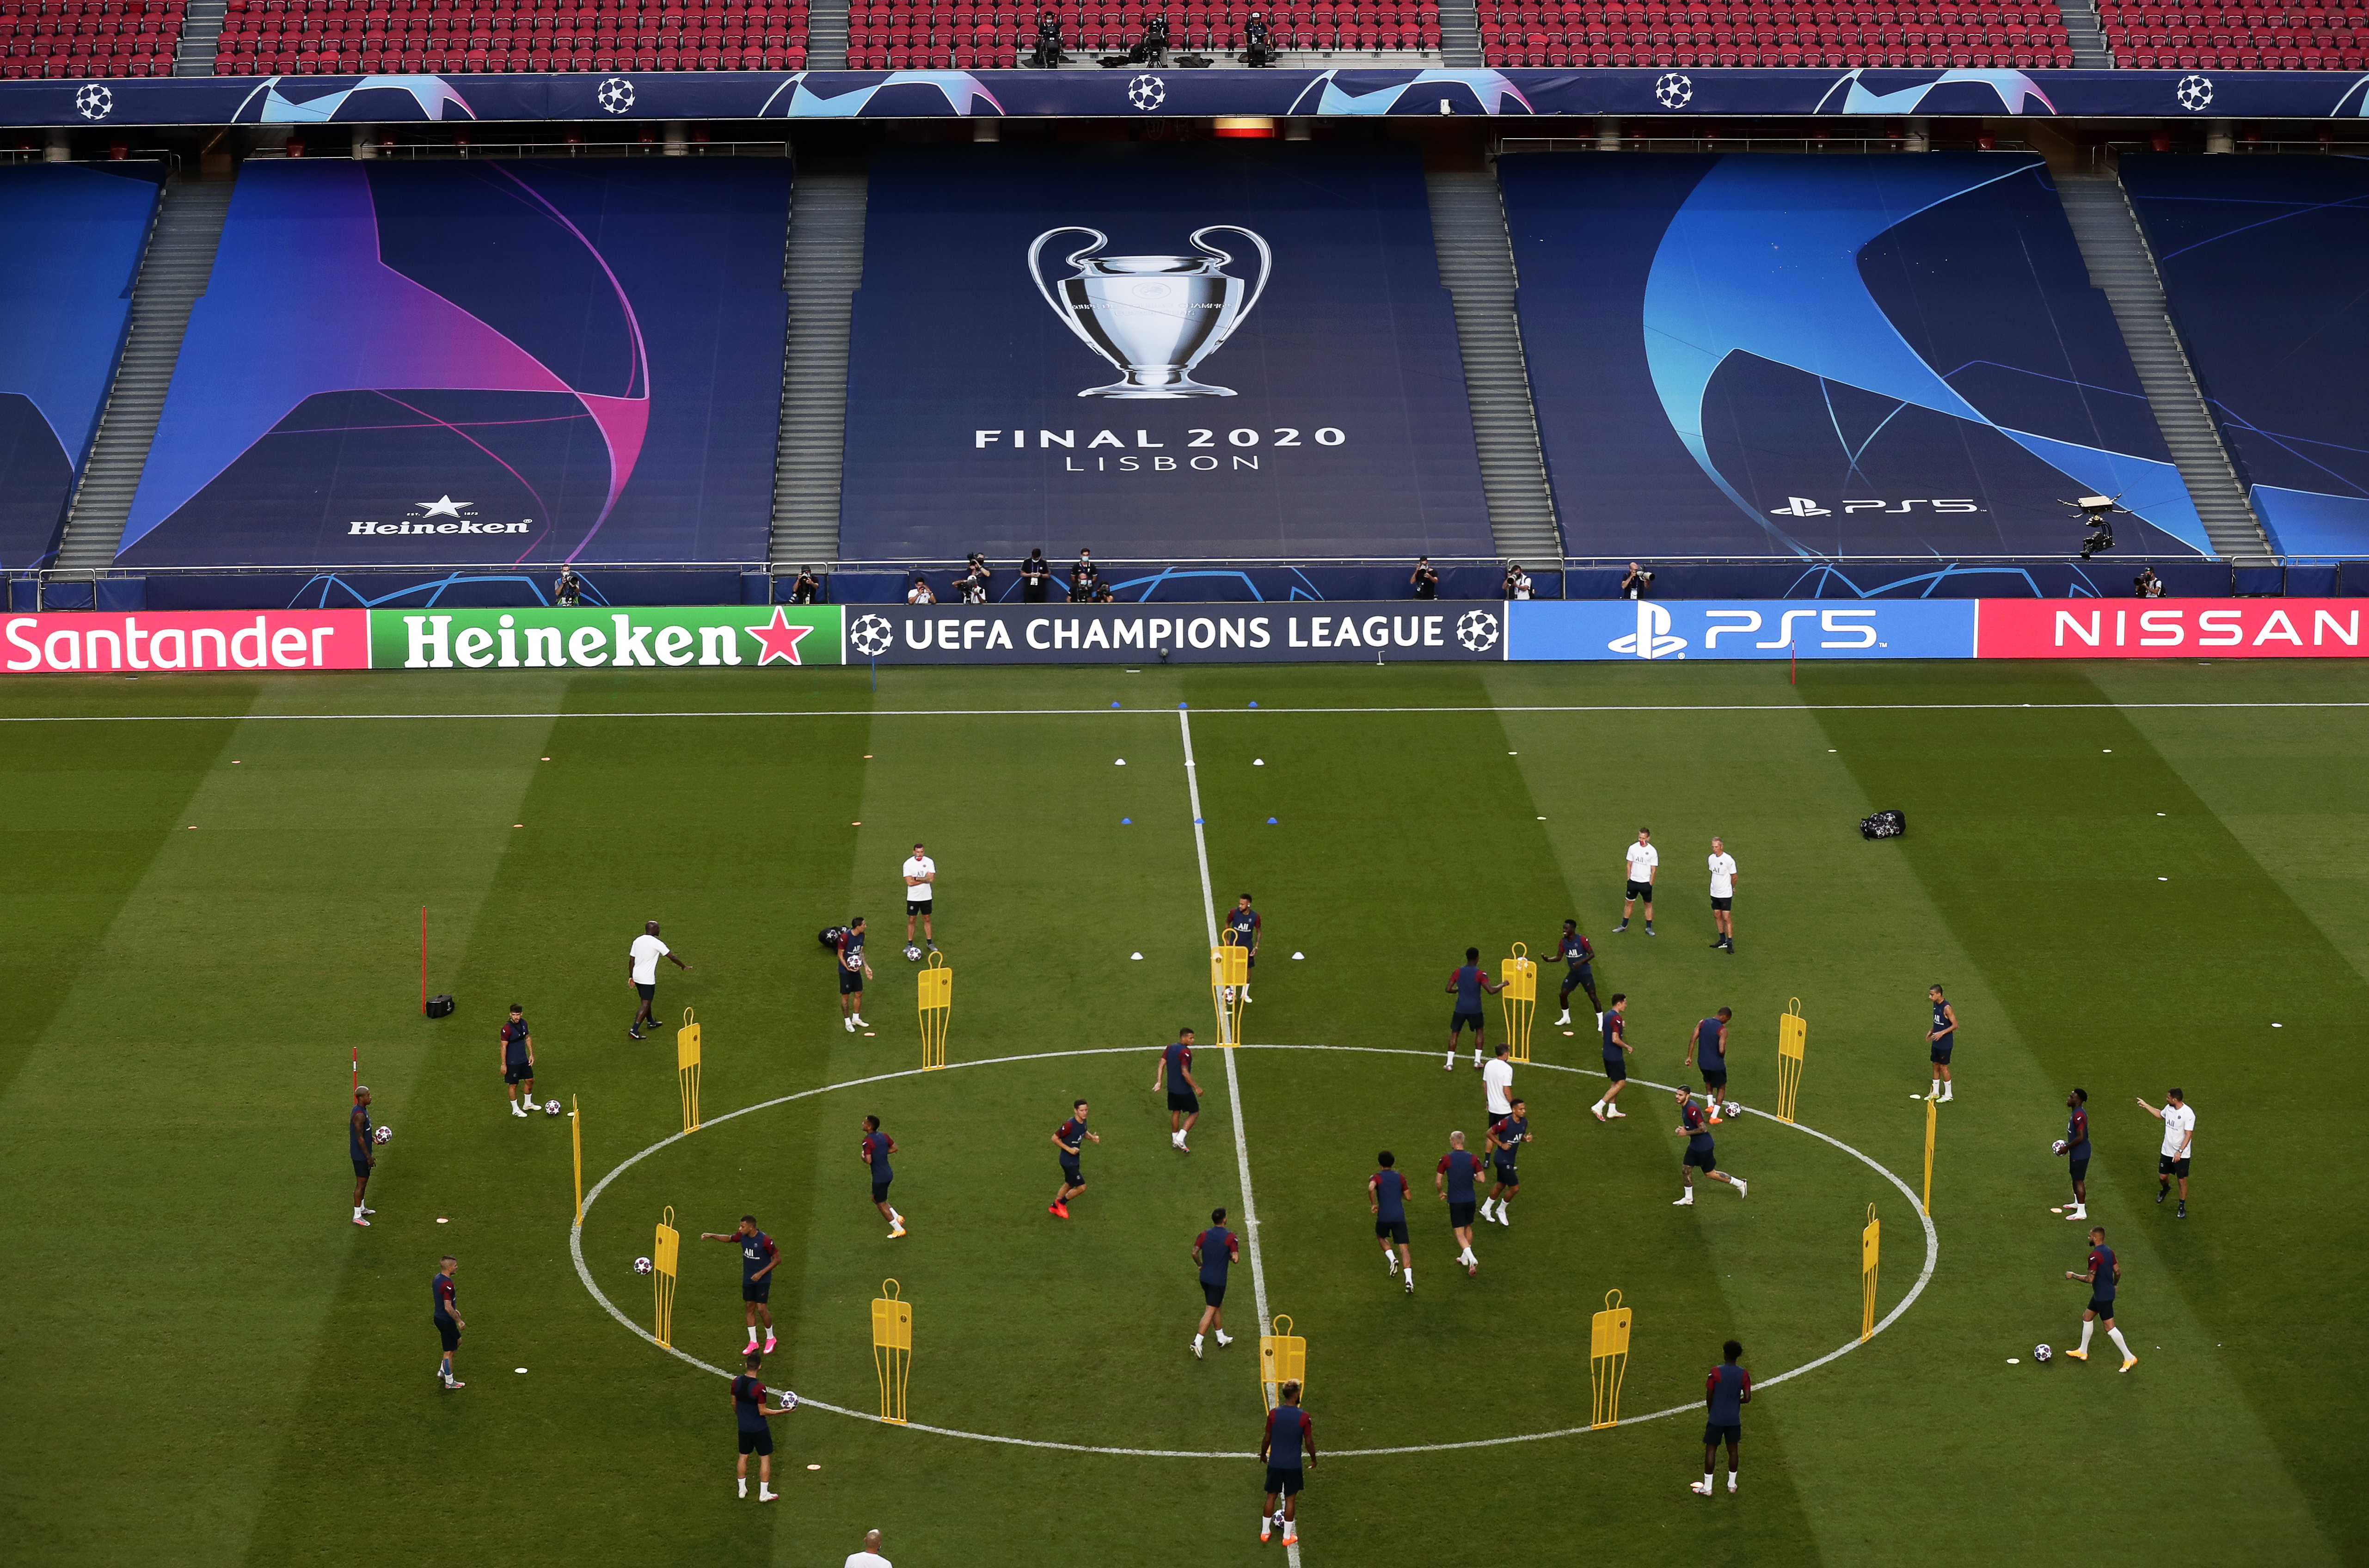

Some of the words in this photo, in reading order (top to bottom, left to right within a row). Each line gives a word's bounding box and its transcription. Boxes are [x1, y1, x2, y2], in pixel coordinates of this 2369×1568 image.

[976, 429, 1164, 448] FINAL
[1188, 427, 1346, 447] 2020
[1066, 455, 1258, 471] LISBON
[1842, 499, 1977, 513] PS5
[348, 521, 529, 535] Heineken
[6, 615, 334, 671] Santander
[403, 614, 742, 668] Heineken
[905, 619, 1013, 649] UEFA
[1026, 617, 1271, 649] CHAMPIONS
[1289, 616, 1444, 647] LEAGUE
[1705, 610, 1877, 649] PS5
[2055, 610, 2359, 646] NISSAN
